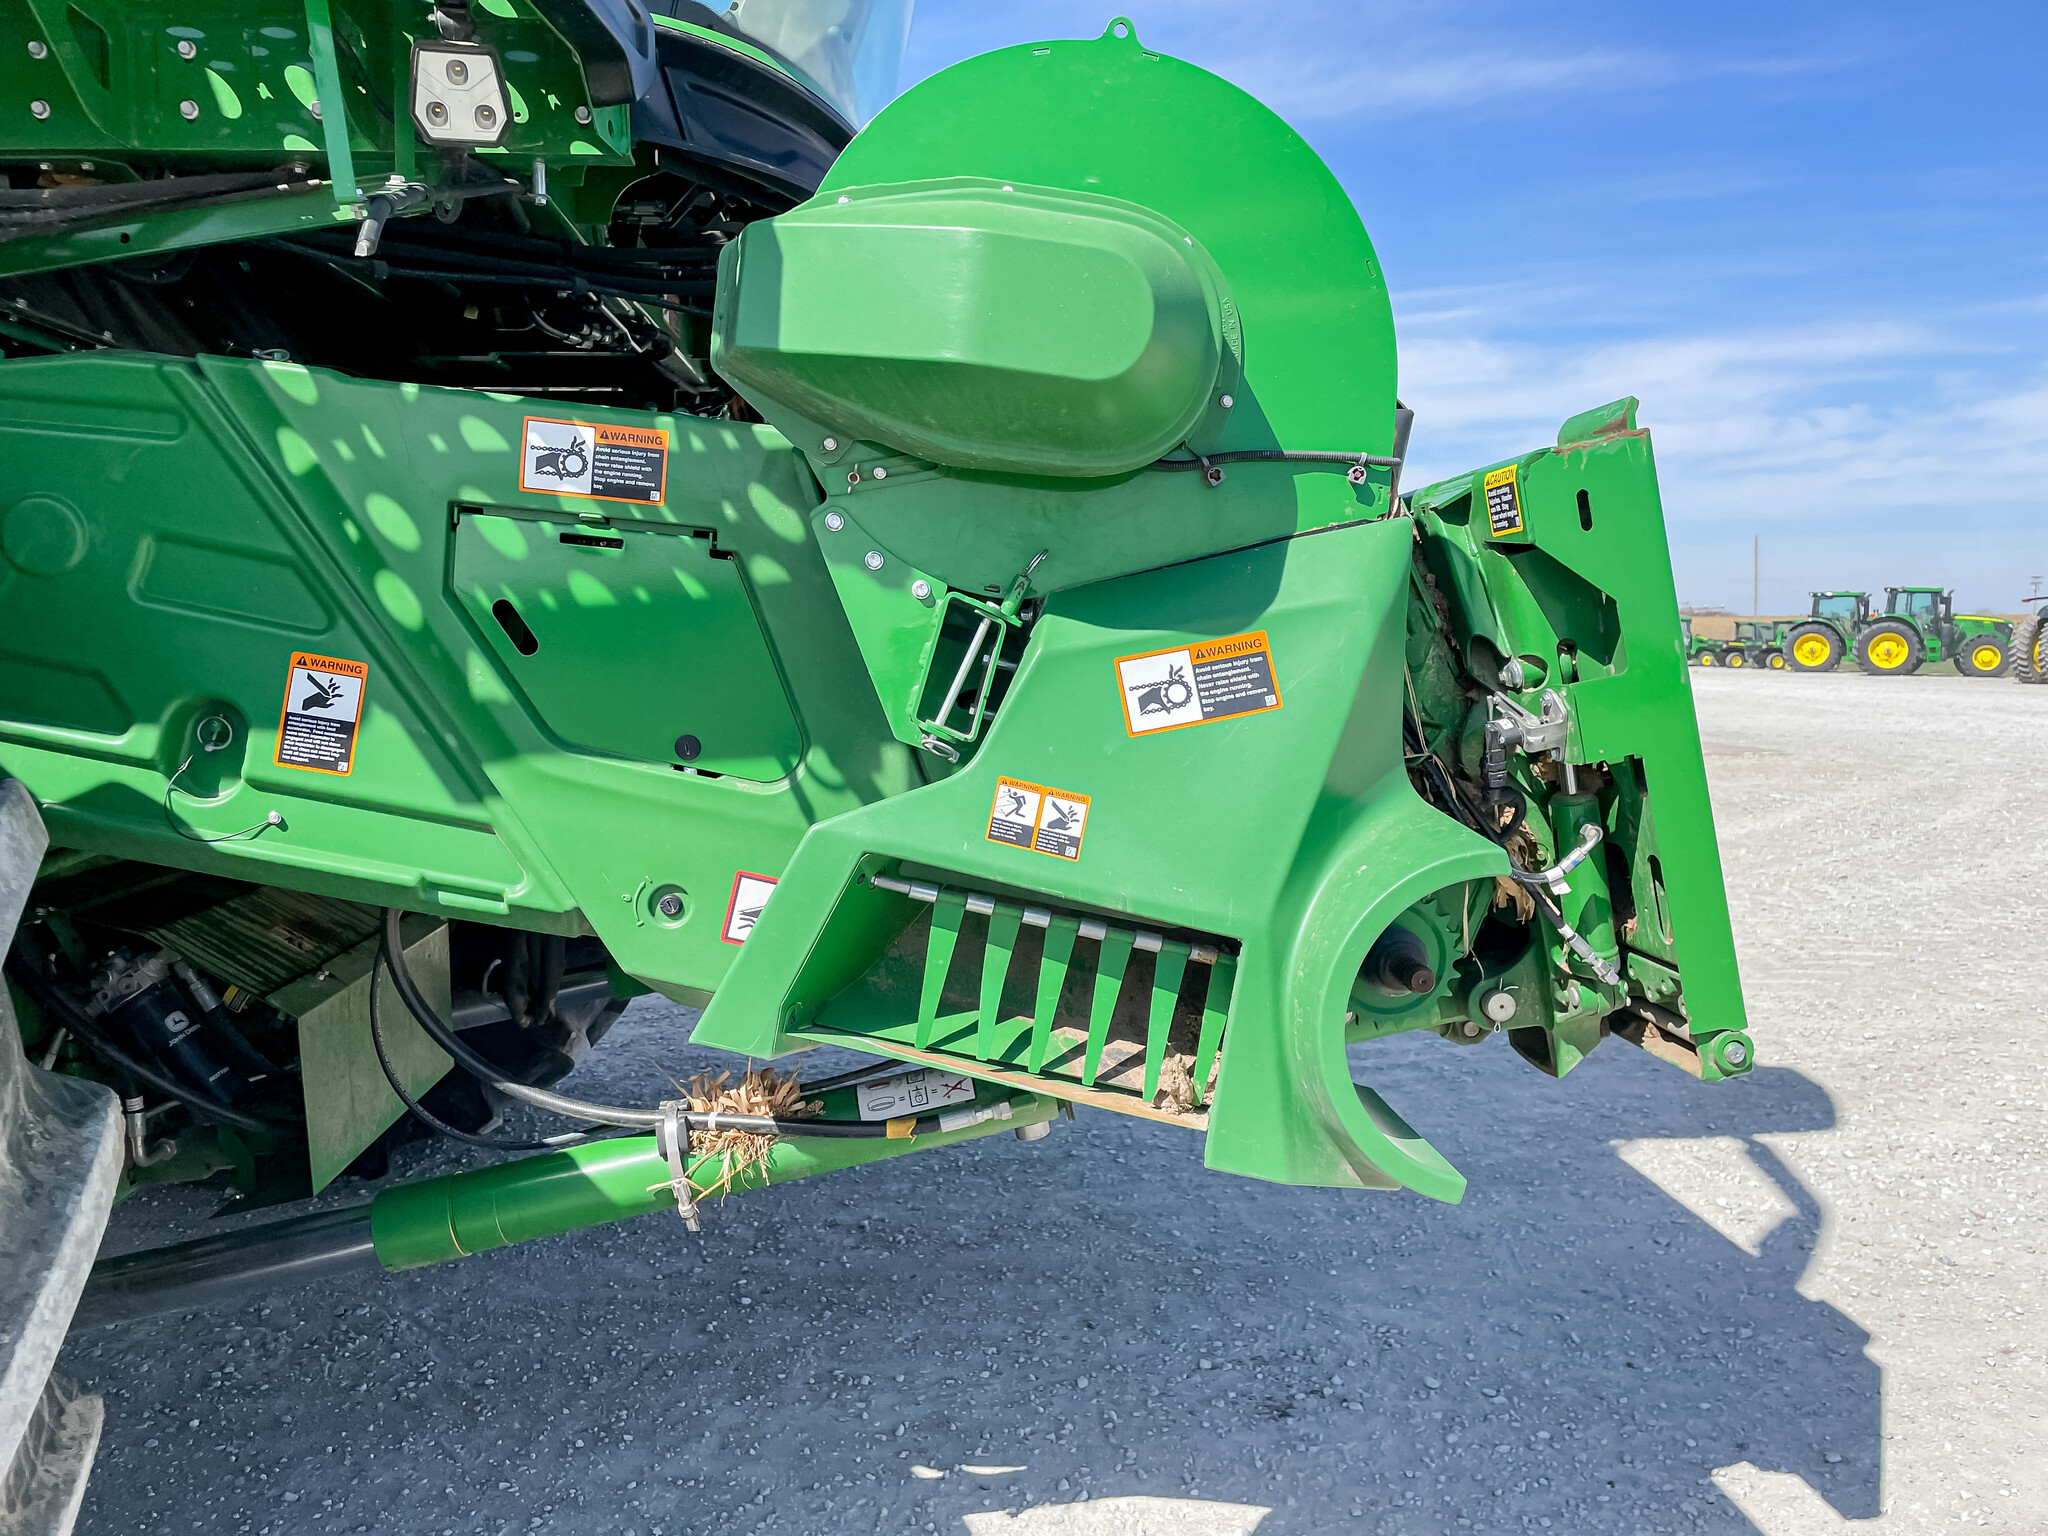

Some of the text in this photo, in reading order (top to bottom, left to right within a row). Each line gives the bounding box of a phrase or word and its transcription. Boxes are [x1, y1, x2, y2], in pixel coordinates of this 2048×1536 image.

[1223, 297, 1232, 316] USA
[1229, 320, 1236, 329] IN
[610, 432, 663, 445] WARNING
[1490, 468, 1515, 485] CAUTION
[1206, 638, 1262, 657] WARNING
[310, 658, 362, 674] WARNING
[1212, 662, 1232, 670] serious
[1233, 658, 1249, 667] injury
[1249, 655, 1263, 663] from
[1198, 681, 1215, 689] Never
[1230, 675, 1247, 683] shield
[1210, 687, 1229, 696] engine
[1229, 682, 1253, 692] running.
[1202, 697, 1215, 705] Stop
[1215, 694, 1235, 703] engine
[1009, 780, 1039, 792] WARNING
[1055, 791, 1086, 802] WARNING
[169, 1034, 185, 1047] JOHN
